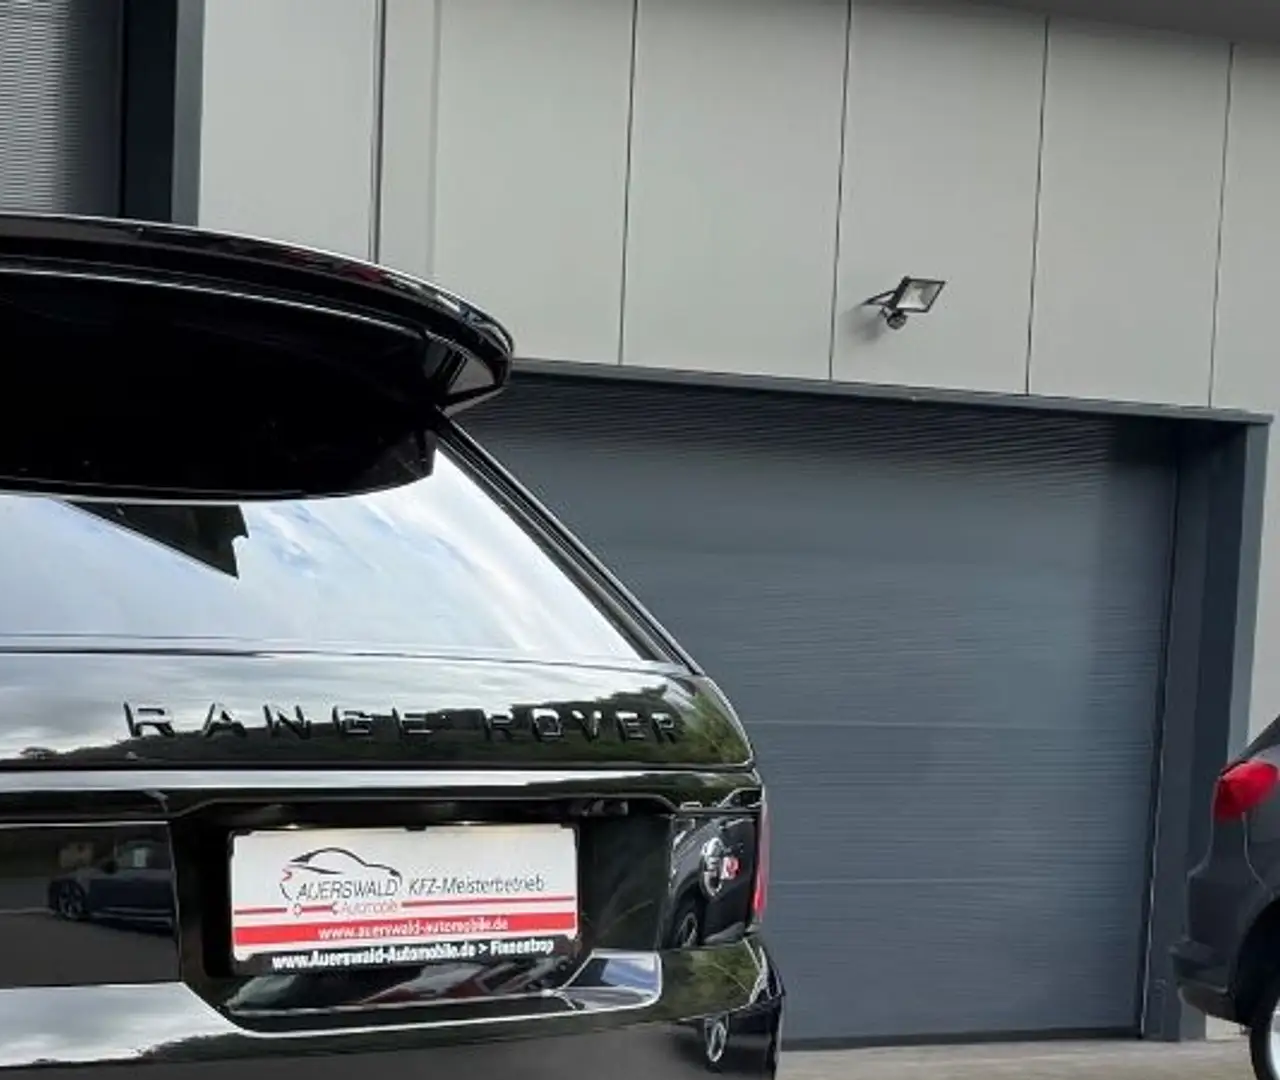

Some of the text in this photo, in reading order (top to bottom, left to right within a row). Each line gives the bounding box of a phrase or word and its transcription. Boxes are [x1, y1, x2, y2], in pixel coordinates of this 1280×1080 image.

[124, 702, 676, 743] RANGE ROVER
[296, 877, 398, 901] AUERSWALD
